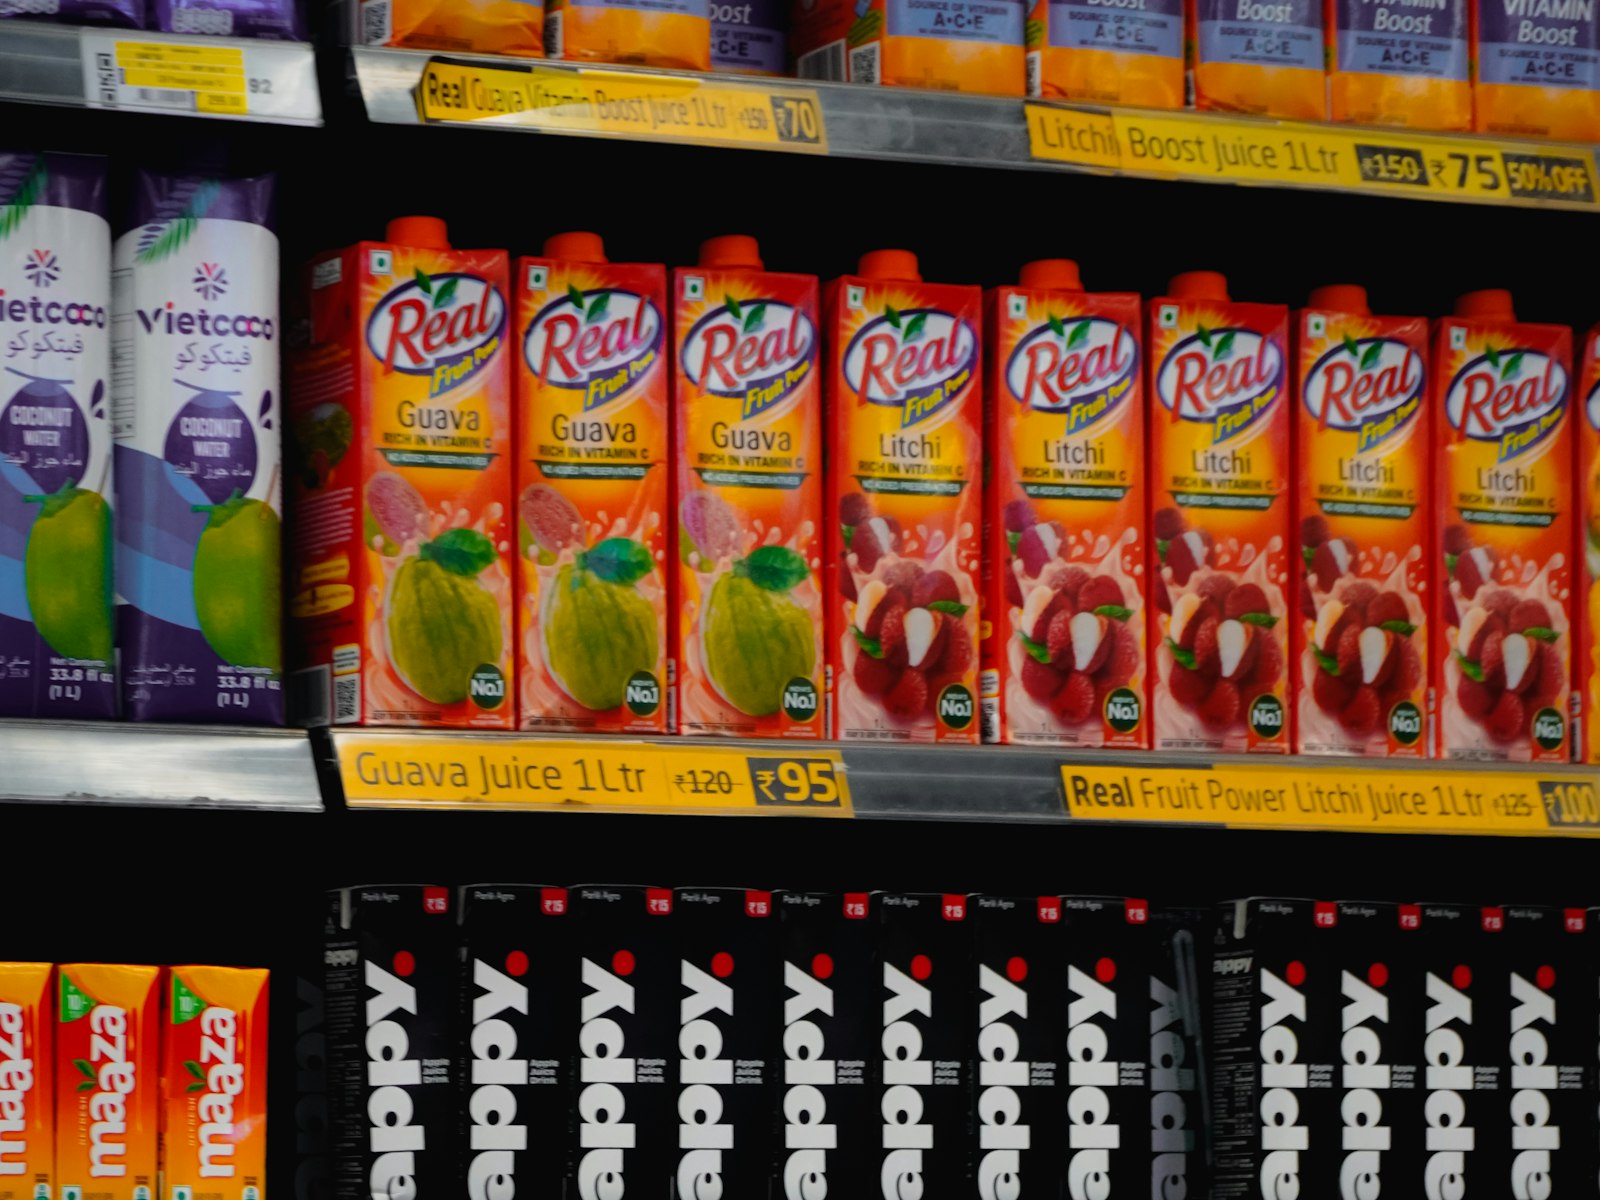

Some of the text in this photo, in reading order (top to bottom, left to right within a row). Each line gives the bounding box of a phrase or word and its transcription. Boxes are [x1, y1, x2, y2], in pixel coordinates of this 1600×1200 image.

[1236, 1, 1293, 23] Boost
[1374, 8, 1433, 34] Boost
[1518, 20, 1578, 46] Boost
[428, 71, 467, 110] Real
[471, 77, 523, 113] Guava
[525, 83, 591, 120] Vitamin
[595, 89, 643, 123] Boost
[648, 91, 689, 130] Juice
[1038, 116, 1122, 157] Litchi
[1129, 126, 1208, 164] Boost
[1214, 135, 1278, 173] Juice
[1283, 140, 1339, 175] 1Ltr
[383, 281, 498, 377] Real
[537, 295, 654, 392] Real
[431, 350, 474, 394] Fruit
[696, 306, 807, 398] Real
[857, 312, 968, 408] Real
[1020, 323, 1130, 416] Real
[1171, 333, 1275, 425] Real
[1317, 347, 1418, 433] Real
[1456, 356, 1560, 443] Real
[396, 400, 480, 431] Guava
[551, 413, 637, 444] Guava
[710, 422, 792, 452] Guava
[879, 433, 942, 460] Litchi
[1043, 440, 1105, 465] Litchi
[1192, 449, 1252, 474] Litchi
[1338, 457, 1395, 483] Litchi
[1477, 467, 1536, 493] Litchi
[356, 751, 469, 787] Guava
[480, 756, 562, 795] Juice
[572, 758, 647, 793] 1Ltr
[1071, 775, 1134, 808] Real
[1140, 778, 1203, 812] Fruit
[1207, 779, 1287, 813] Power
[1293, 782, 1362, 816] Litchi
[1369, 783, 1428, 822] Juice
[1436, 785, 1485, 818] 1Ltr
[89, 1004, 136, 1178] maaza
[198, 1006, 245, 1179] maaza
